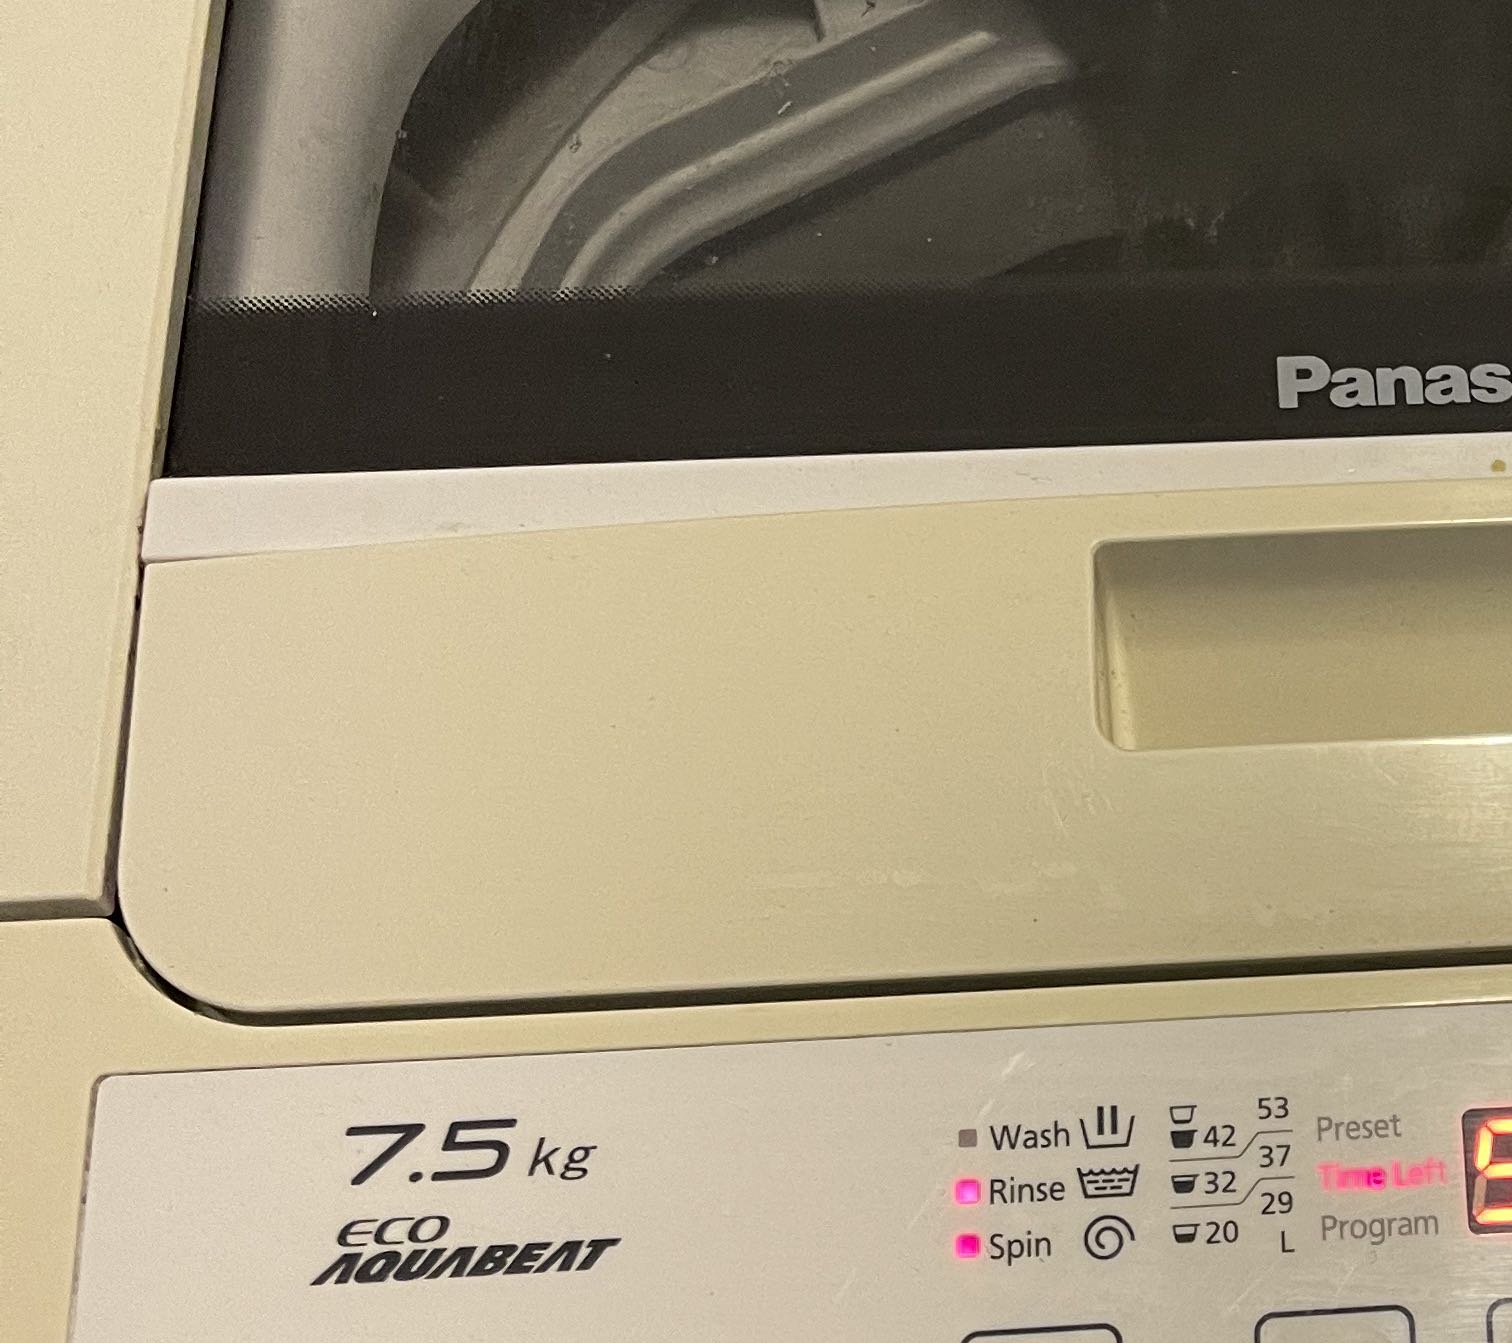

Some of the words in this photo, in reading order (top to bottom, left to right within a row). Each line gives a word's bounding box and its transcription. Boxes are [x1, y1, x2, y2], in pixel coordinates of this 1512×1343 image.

[1258, 1096, 1289, 1120] 53
[990, 1122, 1072, 1150] Wash
[1204, 1125, 1238, 1147] 42
[1318, 1114, 1401, 1140] Preset
[346, 1118, 518, 1185] 7.5
[528, 1137, 598, 1180] kg
[1259, 1145, 1292, 1167] 37
[990, 1177, 1066, 1204] Rinse
[1204, 1171, 1238, 1194] 32
[1317, 1163, 1386, 1191] Time
[1393, 1159, 1448, 1187] Left
[1261, 1192, 1294, 1215] 29
[337, 1215, 450, 1247] ECO
[990, 1232, 1052, 1265] Spin
[1205, 1221, 1239, 1244] 20
[1280, 1230, 1295, 1253] L
[1322, 1215, 1439, 1245] Program
[310, 1238, 621, 1286] AQUABEAT
